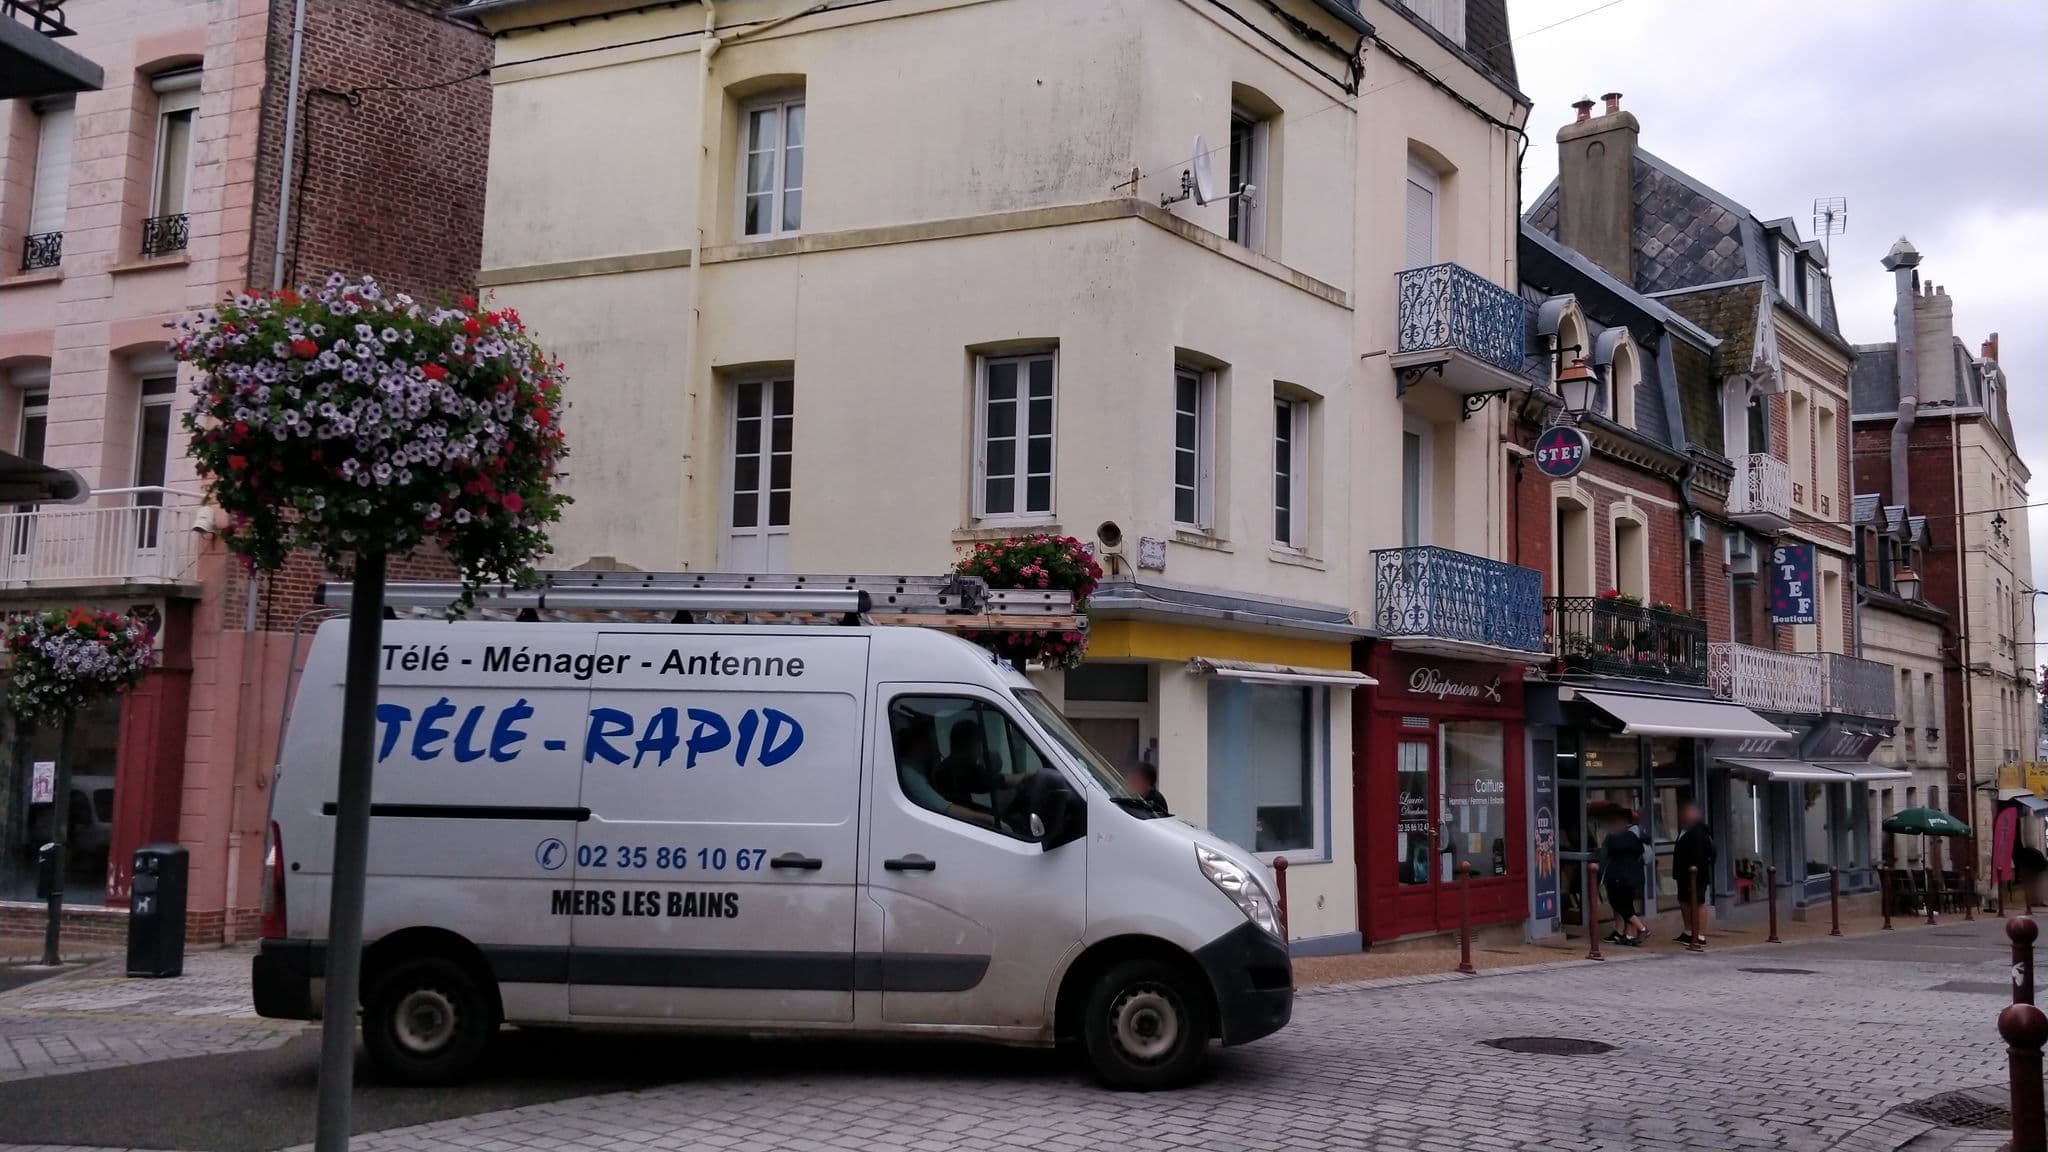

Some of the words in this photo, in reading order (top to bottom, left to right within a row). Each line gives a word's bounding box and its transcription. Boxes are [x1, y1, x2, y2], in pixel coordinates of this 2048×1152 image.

[1538, 445, 1582, 462] STEF
[1773, 548, 1811, 614] STEF
[1772, 615, 1813, 624] Boutique
[382, 645, 449, 671] Télé
[482, 646, 630, 680] Ménager
[659, 649, 805, 677] Antenne
[1408, 667, 1480, 700] Diapason
[375, 696, 535, 763] TÉLÉ
[585, 707, 804, 769] RAPID
[1475, 778, 1504, 793] Coiffure
[577, 845, 607, 868] 02
[616, 846, 648, 869] 35
[656, 847, 687, 870] 86
[697, 848, 727, 870] 10
[736, 849, 767, 871] 67
[551, 889, 616, 917] MERS
[622, 890, 661, 917] LES
[666, 891, 740, 919] BAINS
